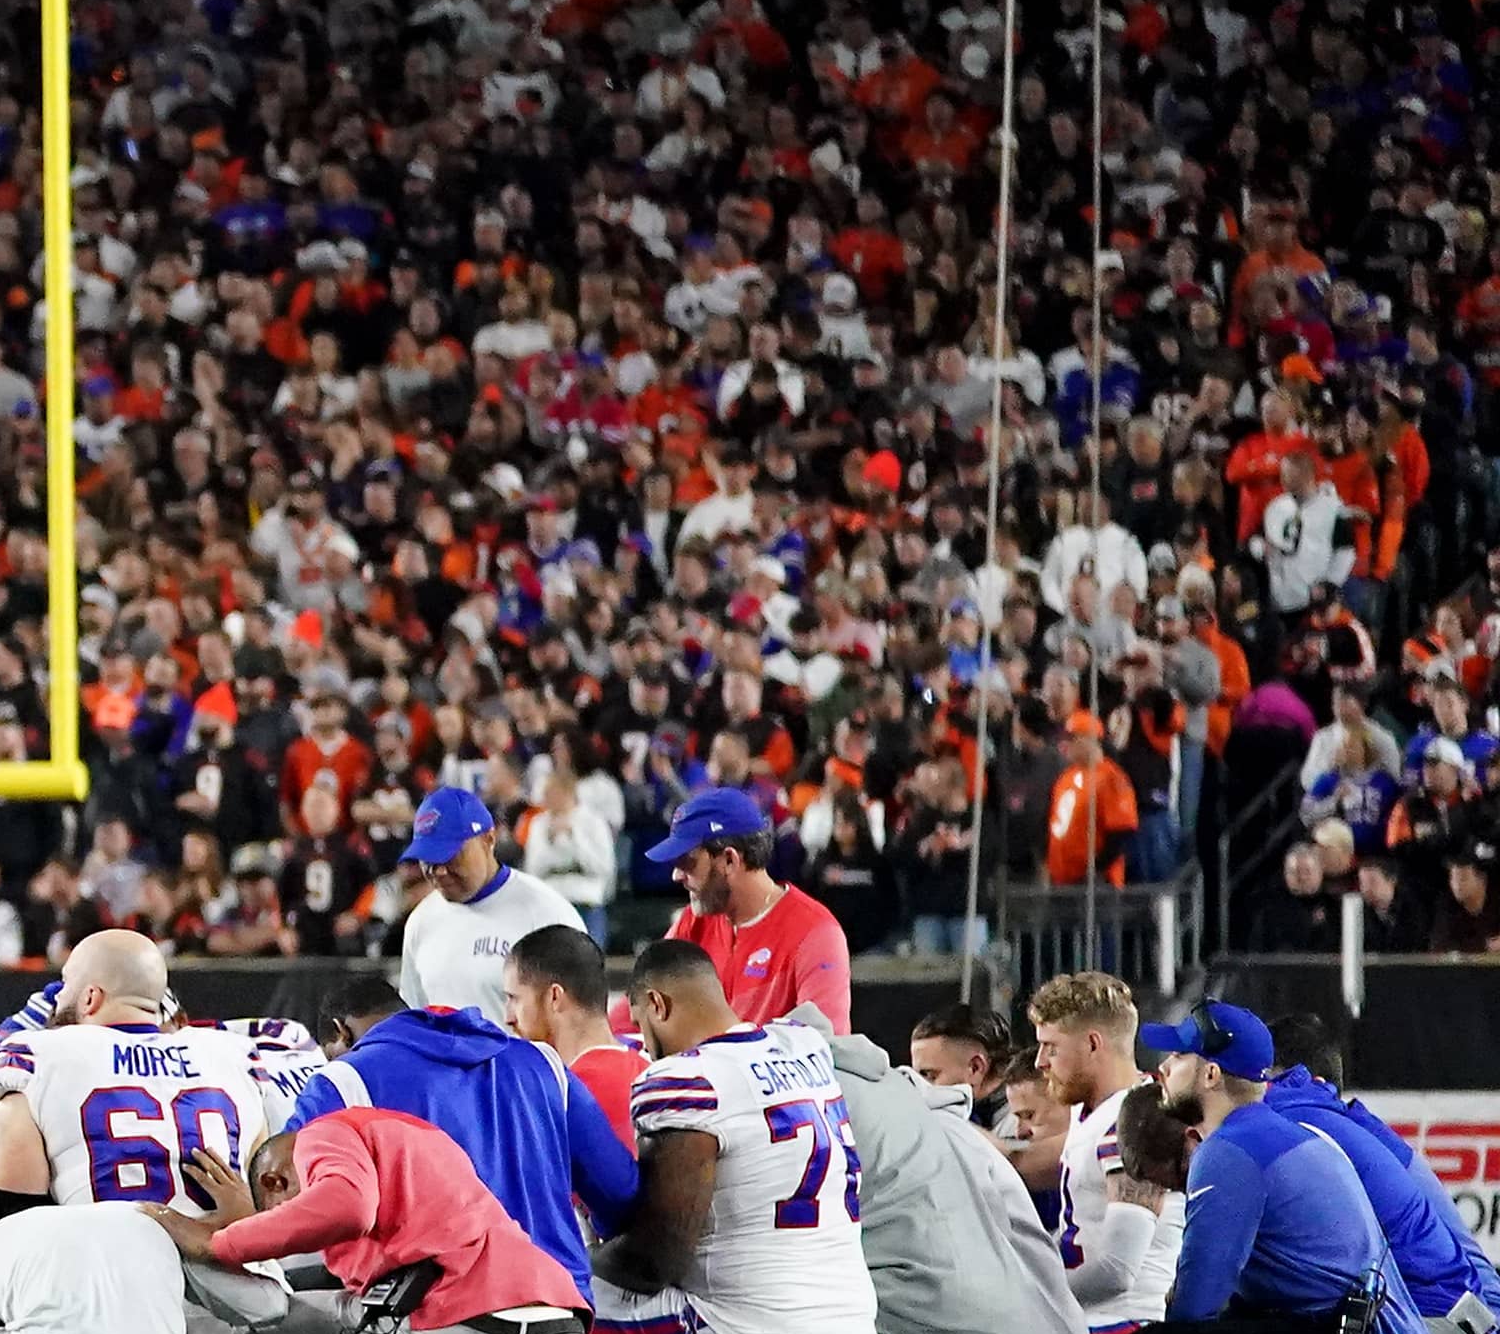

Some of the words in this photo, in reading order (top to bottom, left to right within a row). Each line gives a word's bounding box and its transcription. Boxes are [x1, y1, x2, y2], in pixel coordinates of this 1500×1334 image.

[304, 859, 333, 913] 9
[472, 937, 510, 959] BILLS
[113, 1042, 201, 1079] MORSE
[750, 1051, 833, 1096] SAFFOLD
[79, 1085, 243, 1213] 60
